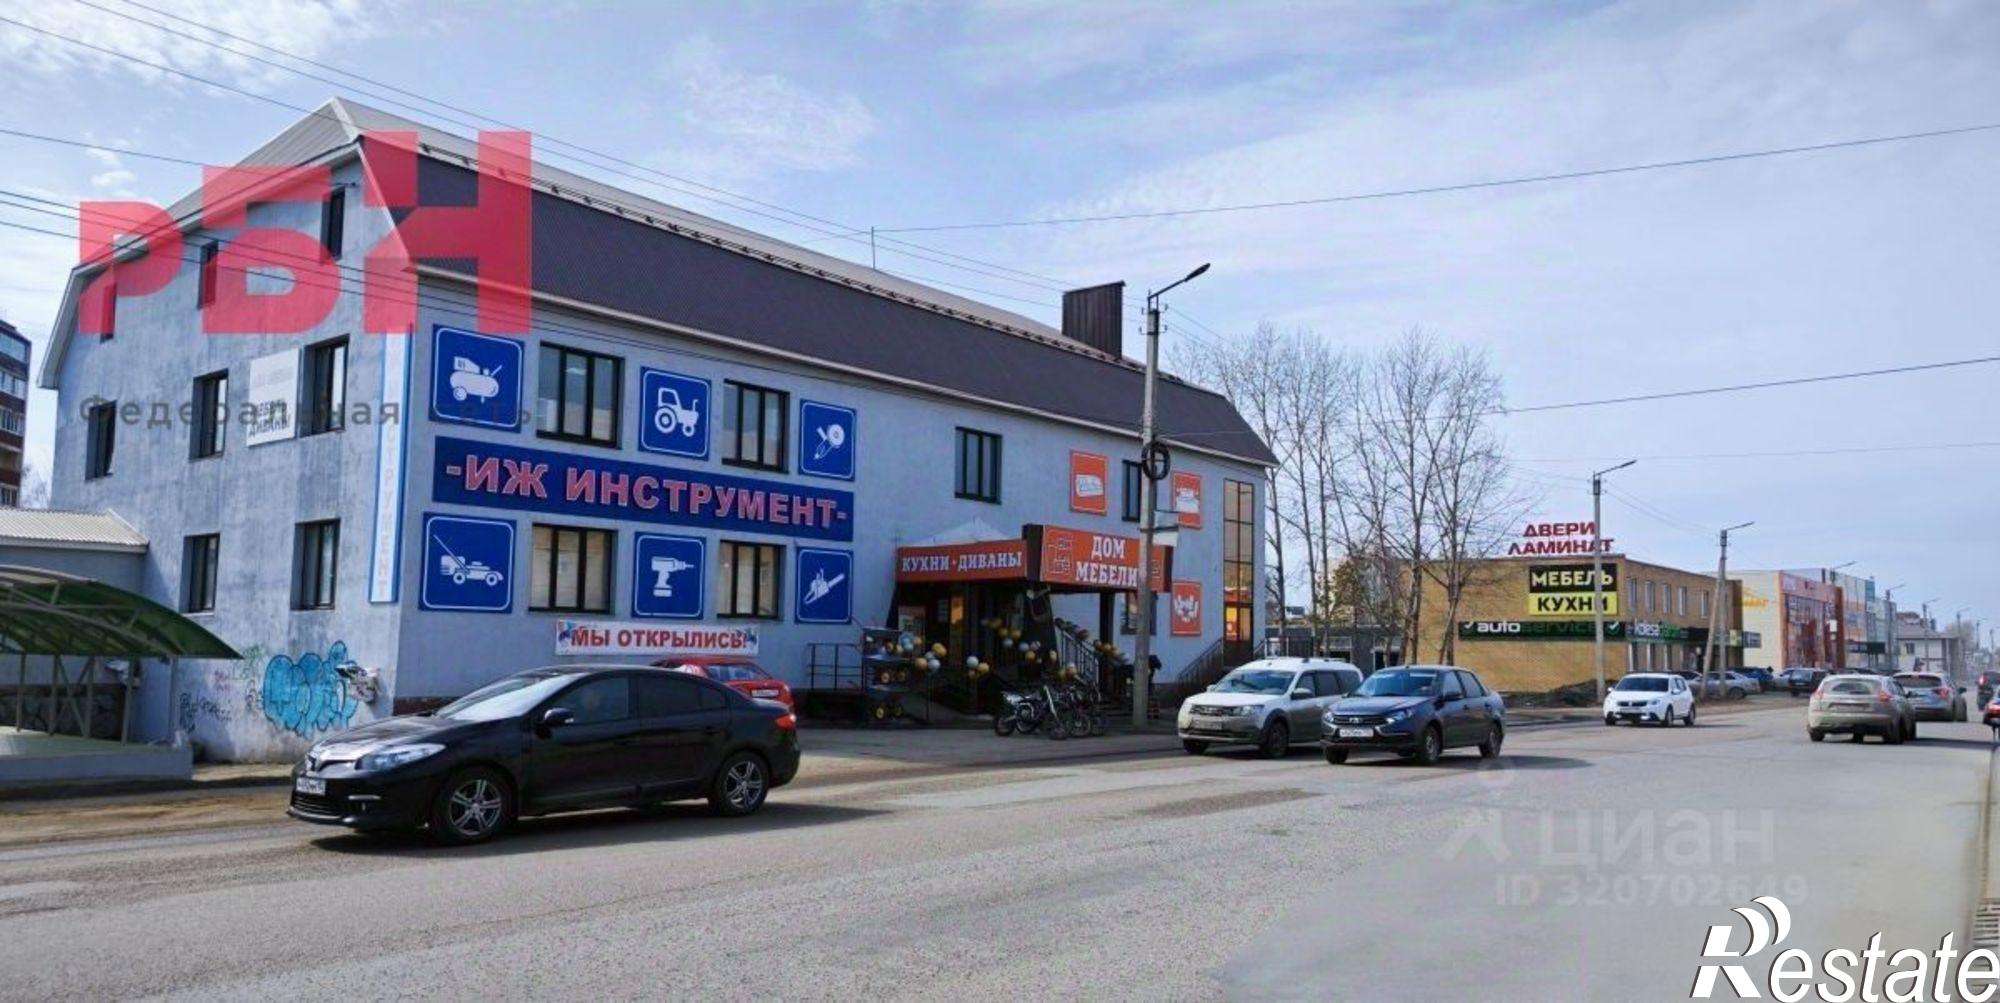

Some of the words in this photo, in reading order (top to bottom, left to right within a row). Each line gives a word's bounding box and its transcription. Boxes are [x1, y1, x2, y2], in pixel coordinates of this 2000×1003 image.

[1523, 521, 1597, 538] ДВЕРИ
[1090, 535, 1126, 561] ДОМ
[1508, 538, 1615, 556] ЛАМИНАТ
[901, 555, 950, 573] КУХНИ
[956, 551, 1024, 571] ДИВАНЫ
[1074, 561, 1139, 588] МЕБЕЛИ
[1531, 570, 1614, 588] МЕБЕЛЬ
[571, 626, 611, 647] МЫ
[617, 628, 748, 650] ОТКРЫЛИСЬ!
